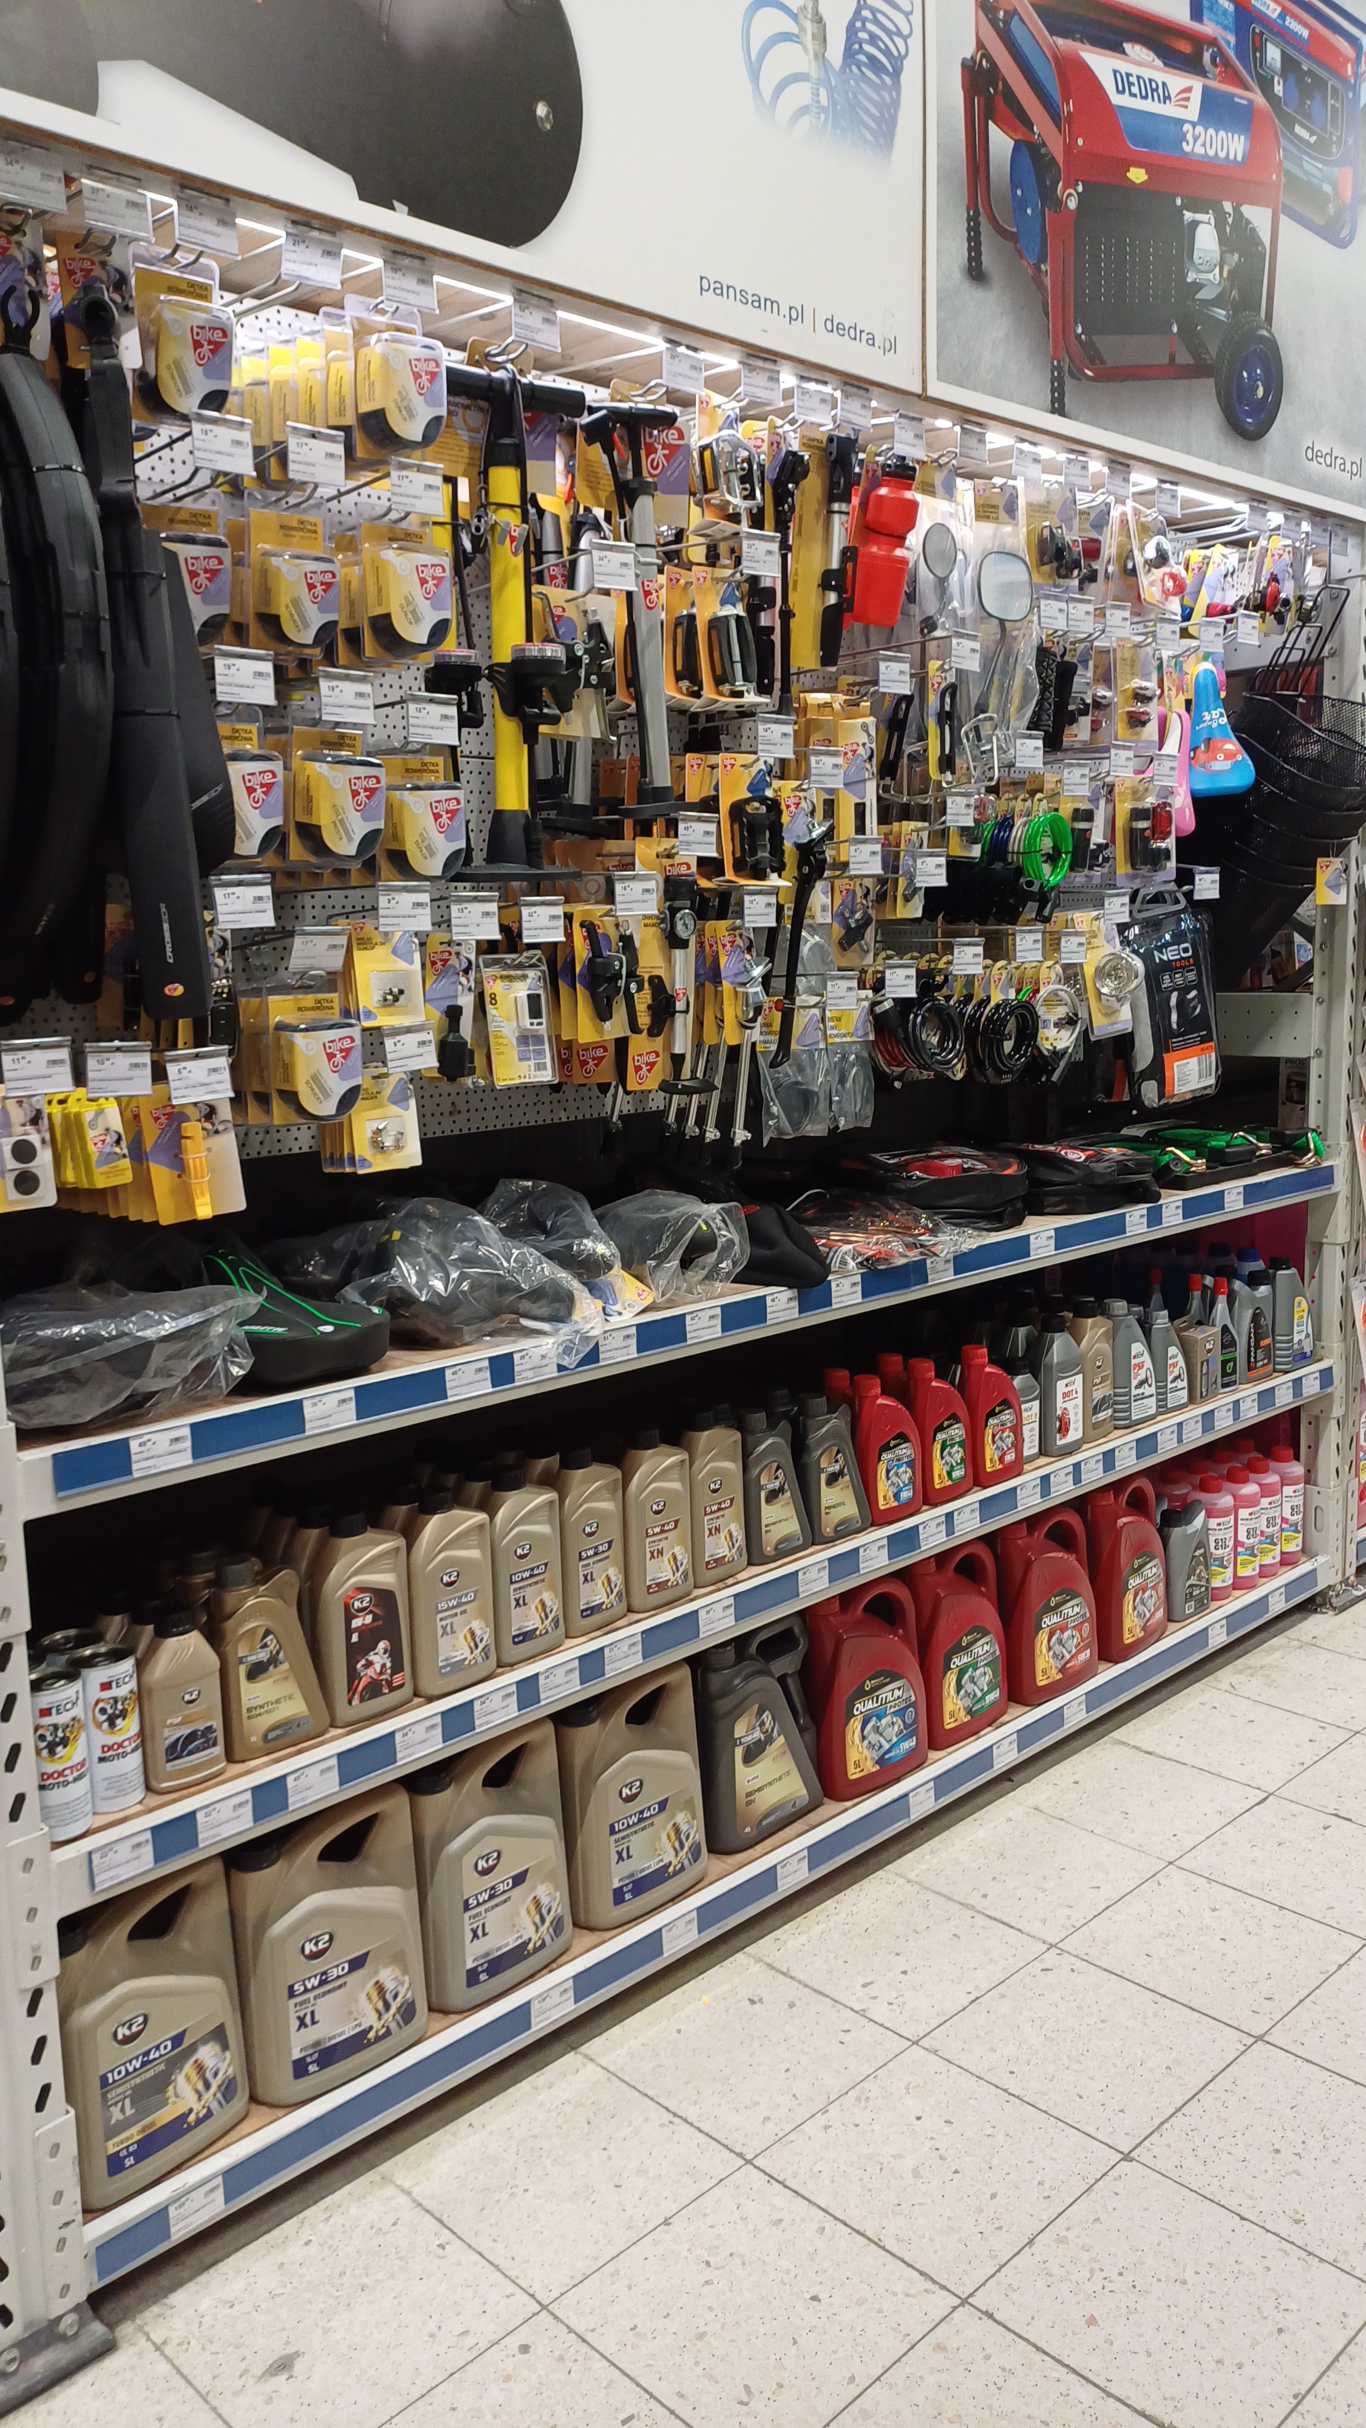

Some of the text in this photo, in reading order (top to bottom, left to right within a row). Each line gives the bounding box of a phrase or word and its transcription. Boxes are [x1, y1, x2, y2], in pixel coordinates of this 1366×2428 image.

[1284, 16, 1310, 39] 2200W
[1112, 68, 1173, 105] DEDRA
[1181, 123, 1245, 163] 3200W
[699, 274, 897, 356] pansam.pl dedra.pl
[193, 325, 228, 342] bike
[411, 358, 440, 371] bike
[645, 426, 685, 445] bike
[1305, 440, 1363, 481] dedra.pl
[187, 556, 224, 571] bike
[418, 564, 446, 578] bike
[306, 571, 337, 584] bike
[245, 771, 278, 786] bike
[351, 775, 382, 789] bike
[432, 798, 462, 814] bike
[665, 862, 692, 875] bike
[430, 950, 452, 961] bike
[1153, 943, 1193, 964] NEO
[1171, 959, 1194, 968] TOOLS
[314, 998, 335, 1008] DĘTKA
[488, 992, 499, 1007] 8
[297, 1004, 335, 1013] ROWEROWA
[325, 1036, 356, 1053] bike
[578, 1046, 609, 1061] bike
[633, 1051, 661, 1066] bike
[1205, 1341, 1215, 1349] K2
[1133, 1361, 1146, 1372] PSF
[1062, 1390, 1073, 1400] DOT
[710, 1480, 722, 1492] K2
[652, 1501, 665, 1513] K2
[705, 1499, 731, 1514] 5W-40
[584, 1522, 598, 1534] K2
[647, 1521, 676, 1536] 5W-40
[707, 1524, 721, 1539] XN
[516, 1544, 531, 1556] K2
[581, 1542, 609, 1559] 5W-30
[648, 1547, 664, 1561] XN
[442, 1571, 459, 1584] K2
[511, 1565, 546, 1583] 10W-40
[582, 1571, 596, 1585] XL
[1128, 1565, 1158, 1589] QUALITIUM
[353, 1597, 371, 1609] K2
[437, 1592, 476, 1611] 15W-40
[513, 1594, 528, 1610] XL
[1041, 1603, 1082, 1628] QUALITIUM
[439, 1622, 457, 1639] XL
[950, 1641, 992, 1669] QUALITIUM
[183, 1691, 200, 1702] K2
[853, 1685, 905, 1716] QUALITIUM
[622, 1780, 641, 1799] K2
[613, 1803, 659, 1833] 10W-40
[614, 1821, 655, 1845] SEMISYNTHETIC
[477, 1851, 499, 1872] K2
[615, 1845, 633, 1866] XL
[468, 1877, 513, 1909] 5W-30
[468, 1895, 512, 1922] FUEL ECONOMY
[469, 1921, 490, 1944] XL
[303, 1932, 331, 1956] K2
[293, 1961, 349, 1996] 5W-30
[294, 1981, 348, 2010] FUEL ECONOMY
[116, 2015, 145, 2042] K2
[295, 2009, 320, 2034] XL
[105, 2039, 172, 2084] 10W-40
[106, 2061, 166, 2101] SEMISYNTHETIC
[109, 2098, 136, 2126] XL
[112, 2133, 135, 2149] TURBO
[124, 2156, 136, 2169] 5L
